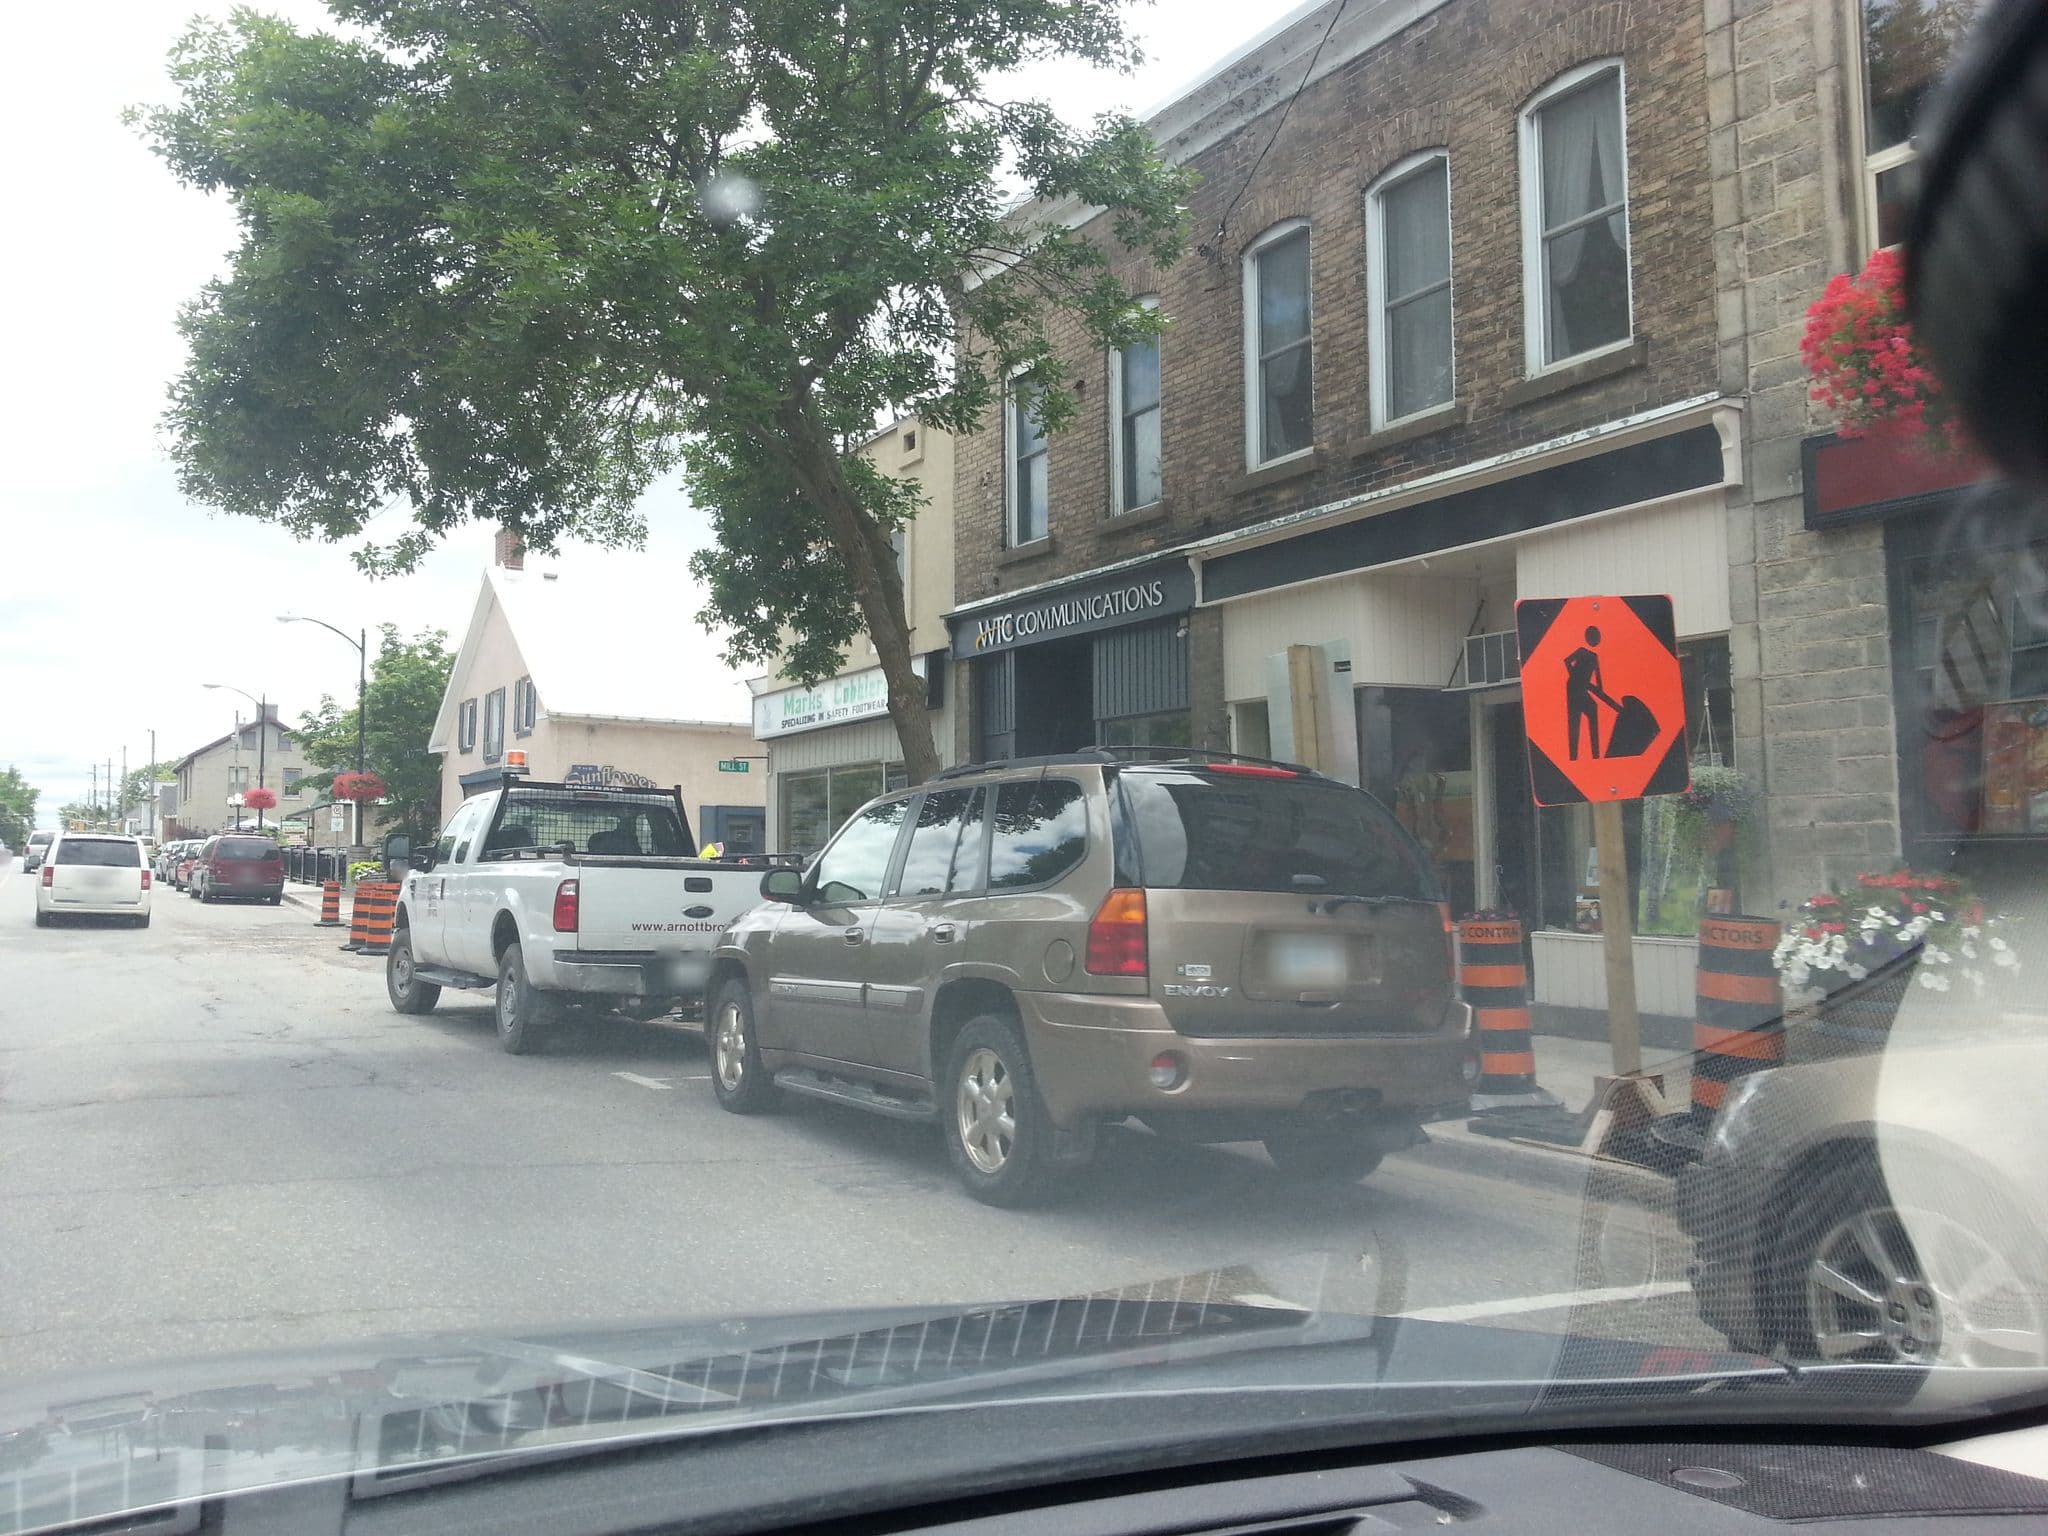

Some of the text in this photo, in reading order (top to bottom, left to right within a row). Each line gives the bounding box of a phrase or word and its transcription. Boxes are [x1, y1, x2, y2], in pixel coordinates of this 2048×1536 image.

[976, 581, 1163, 650] WTC COMMUNICATIONS
[781, 699, 886, 729] SPECIALIZING IN SAFETY FOOTWEAR
[739, 762, 747, 771] ST
[1163, 984, 1231, 997] ENVOY
